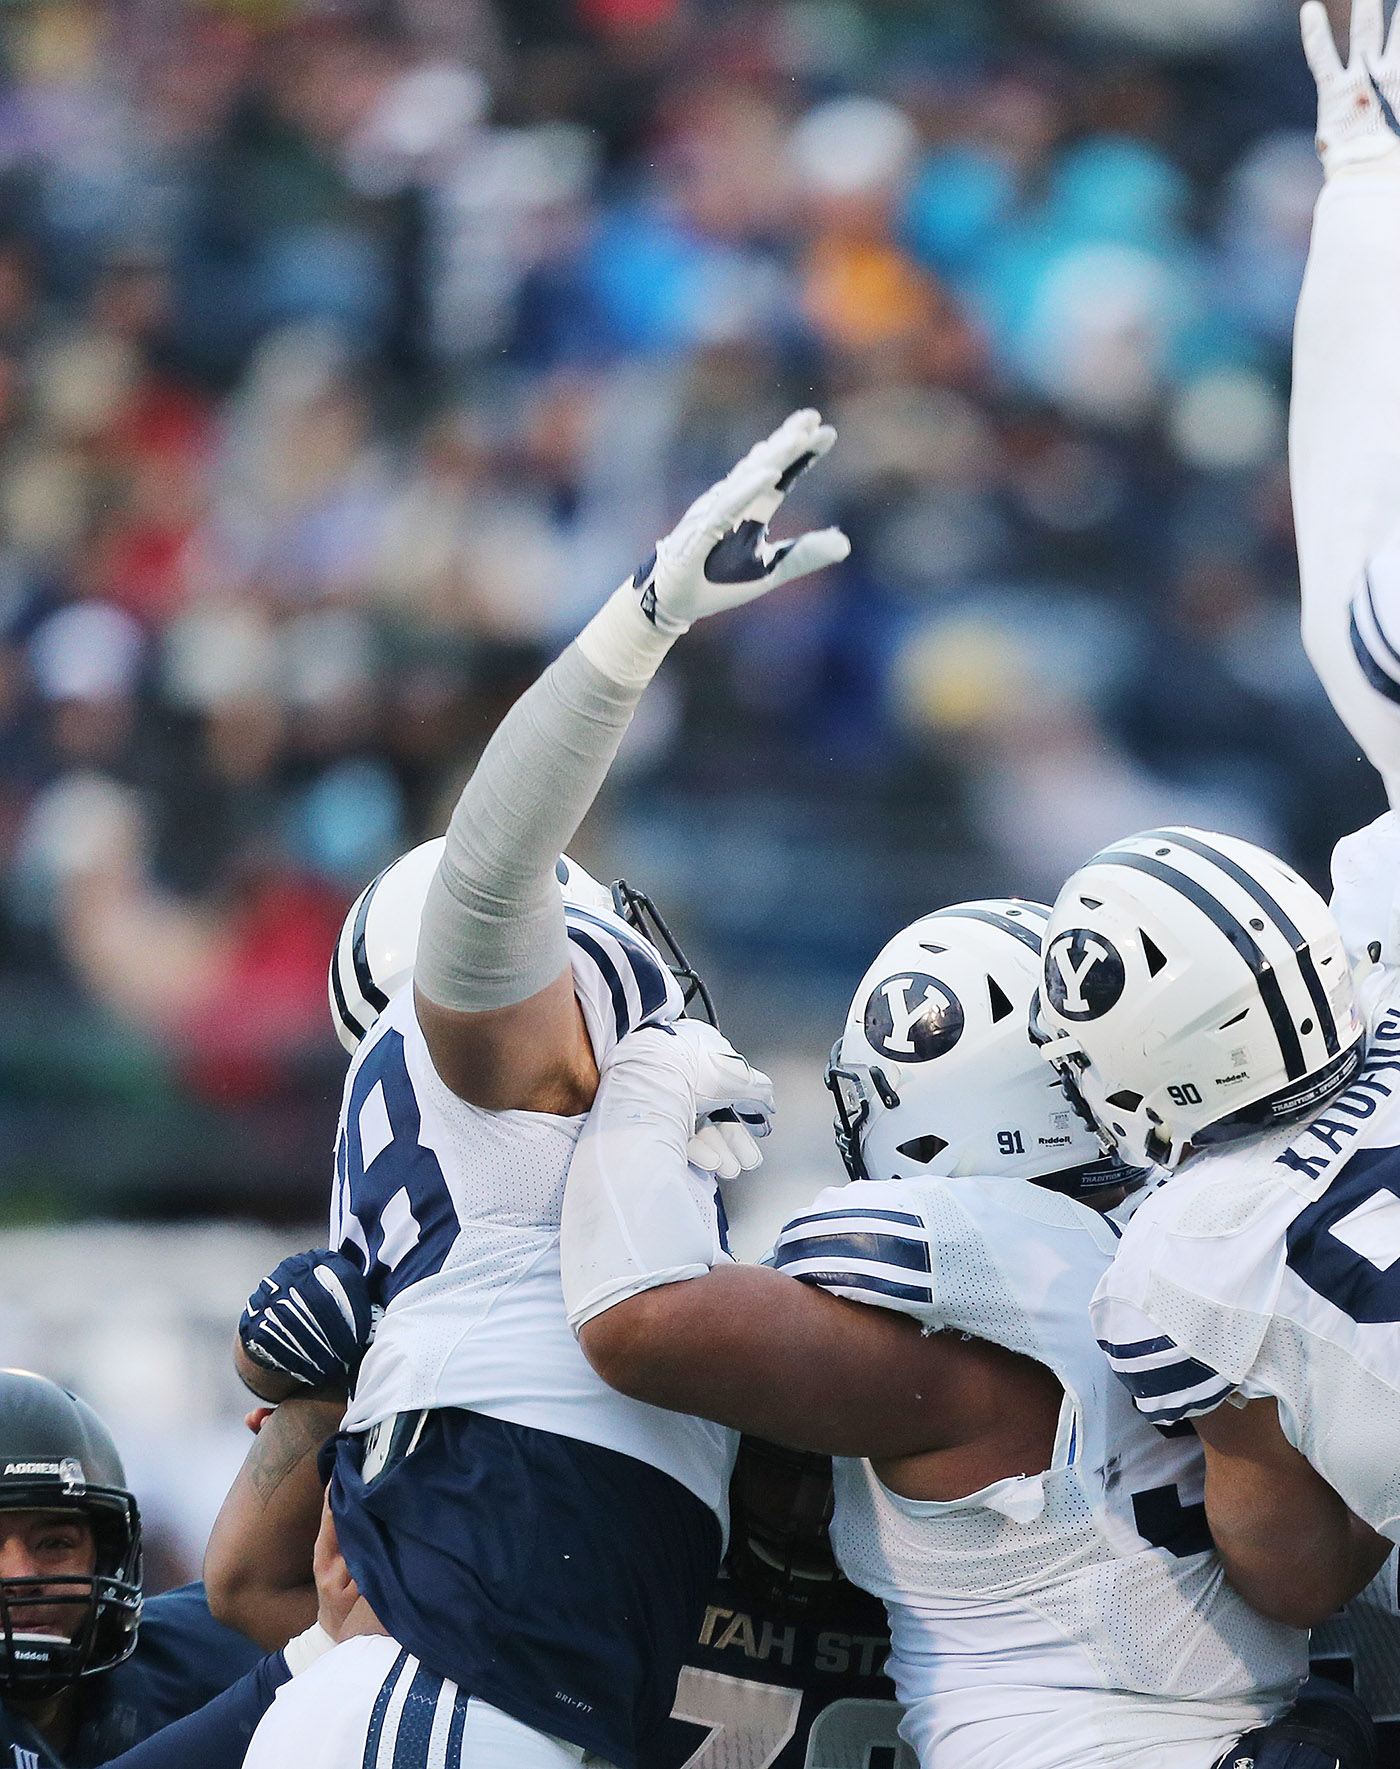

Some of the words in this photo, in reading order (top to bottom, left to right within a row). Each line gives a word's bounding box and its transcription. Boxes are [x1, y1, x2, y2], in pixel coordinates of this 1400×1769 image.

[1050, 936, 1109, 1012] Y
[881, 978, 951, 1053] Y
[1167, 1083, 1202, 1106] 90
[997, 1130, 1025, 1155] 91
[1038, 1136, 1072, 1145] Riddell
[698, 1604, 797, 1666] TAH
[814, 1631, 892, 1677] ST
[555, 1691, 593, 1713] DRI-FIT
